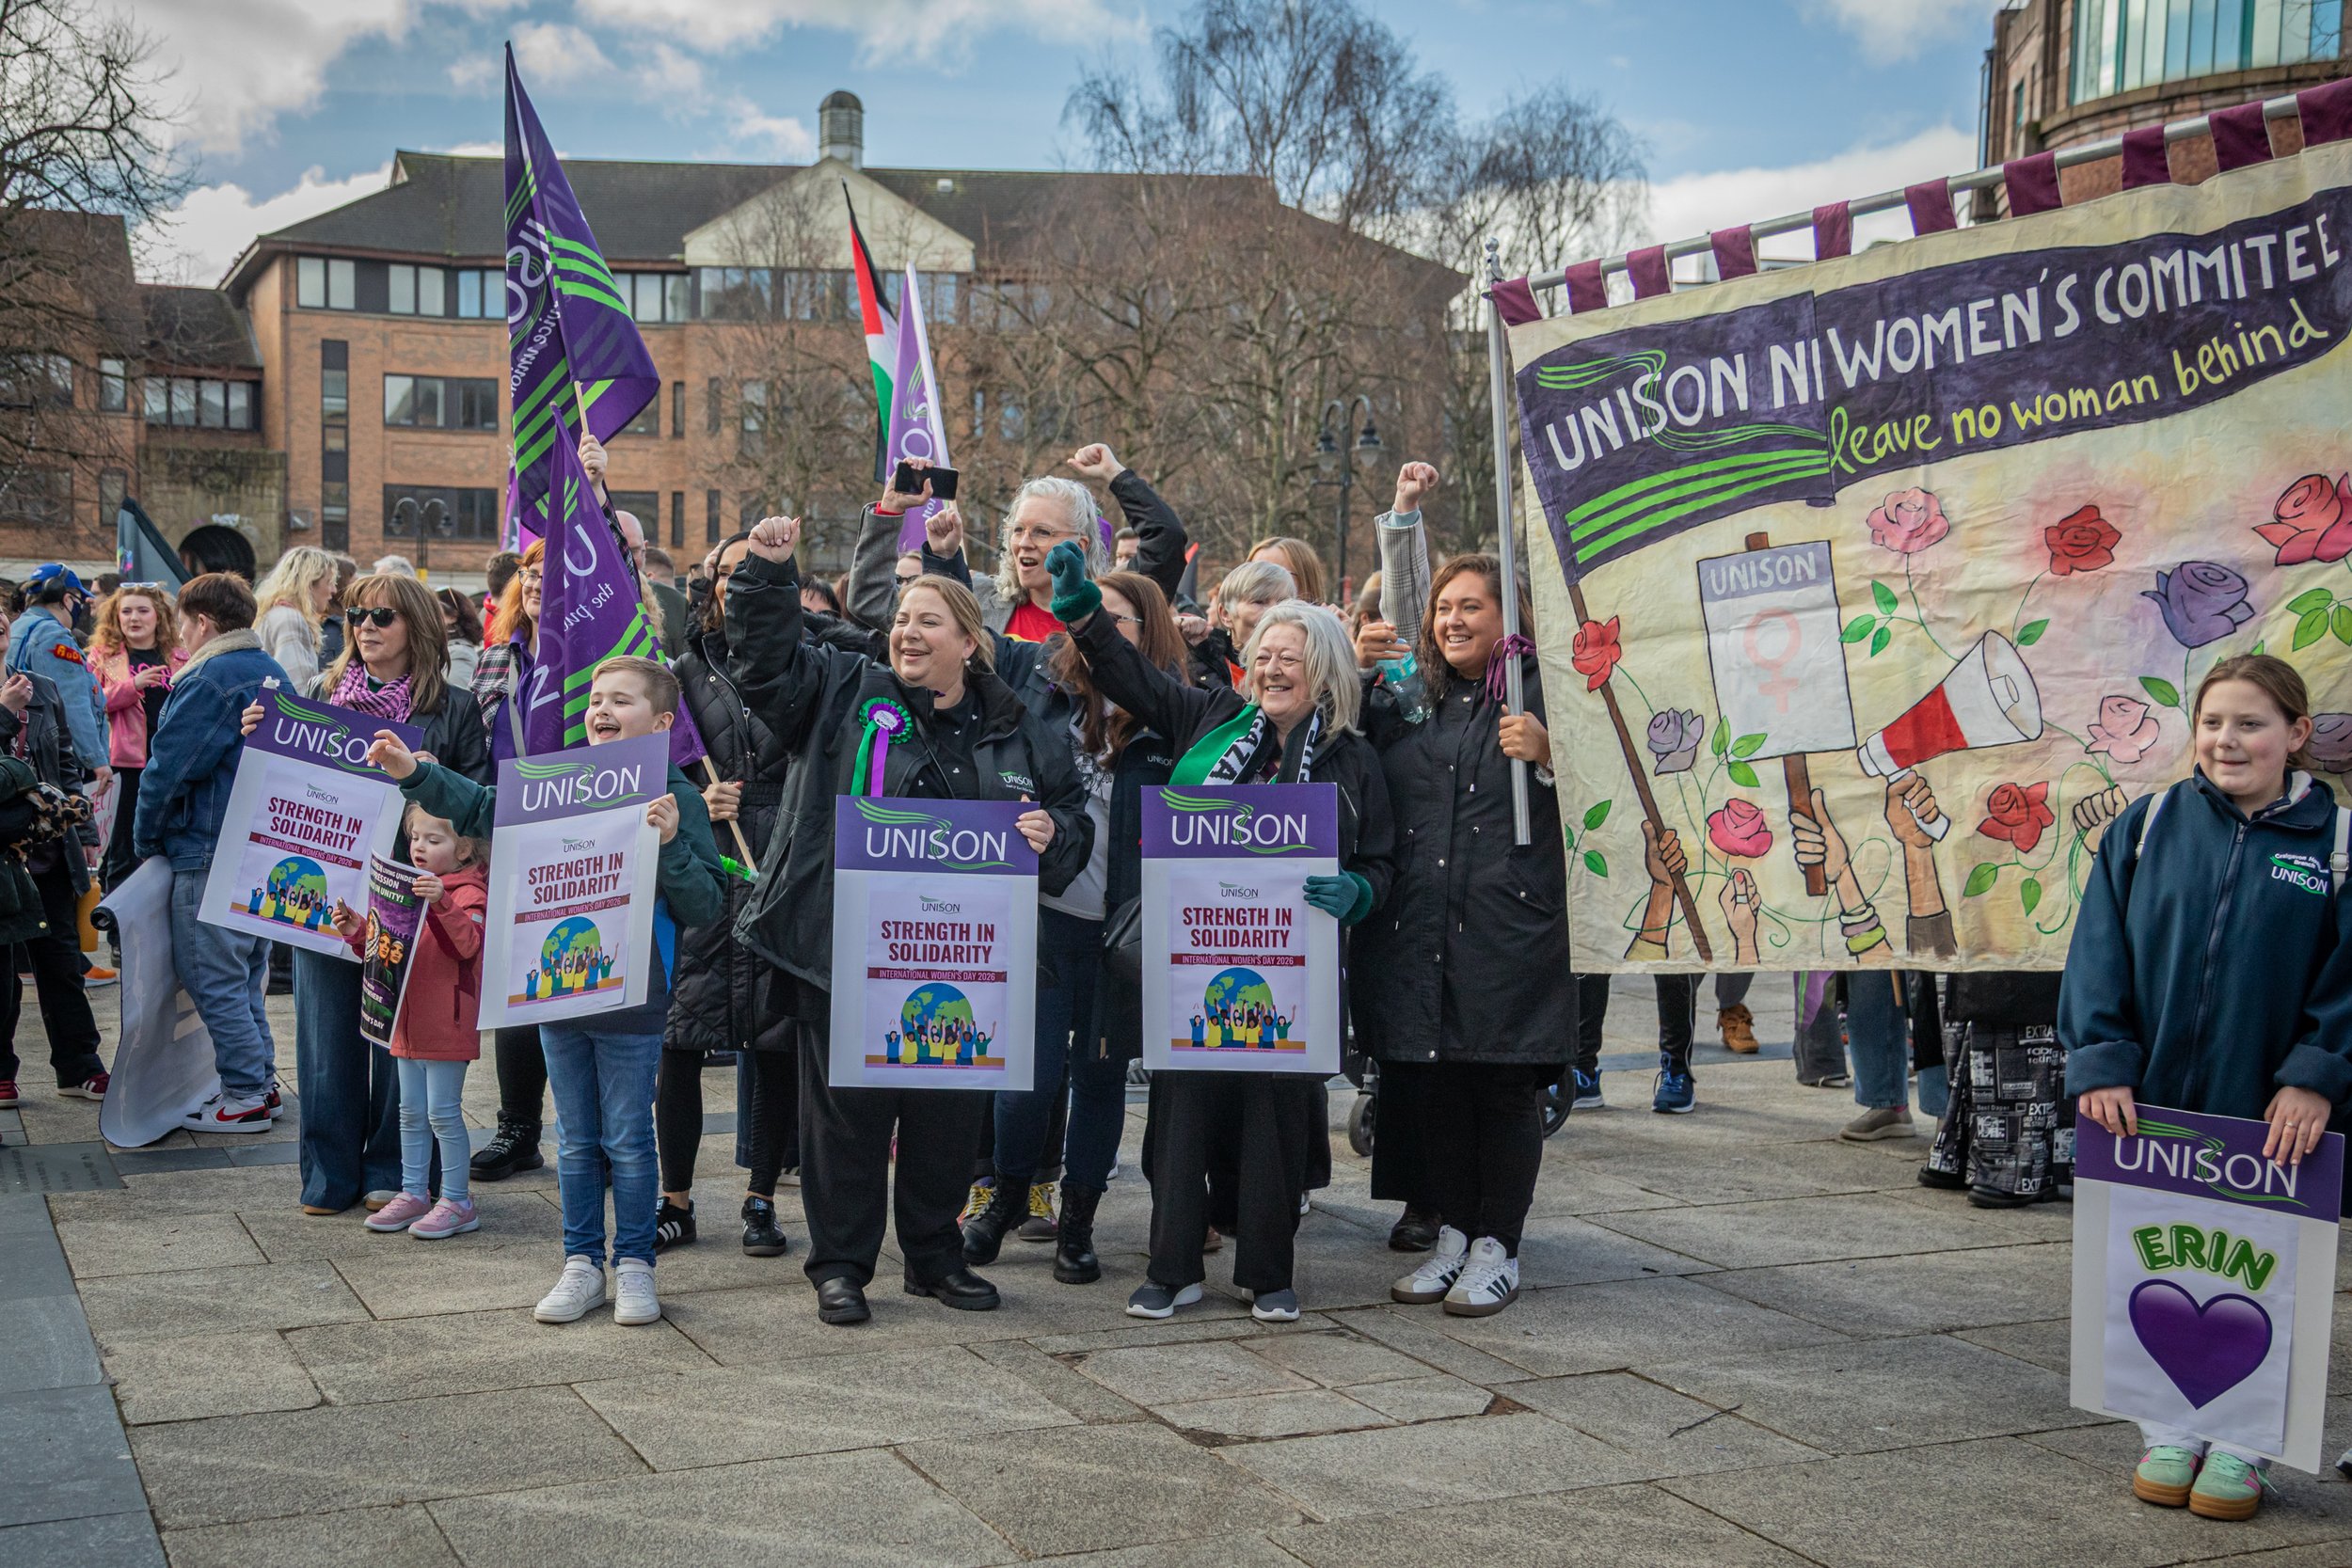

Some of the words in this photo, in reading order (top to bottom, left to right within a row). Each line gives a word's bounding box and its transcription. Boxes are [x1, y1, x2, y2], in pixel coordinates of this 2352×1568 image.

[1546, 354, 1748, 470] UNISON
[1770, 338, 1824, 409] NI
[1826, 267, 2080, 388] WOMEN'S
[2094, 213, 2340, 325] COMMITEE
[1830, 405, 1942, 474] leave
[1951, 403, 2002, 444] no
[2010, 374, 2159, 431] woman
[2172, 297, 2328, 397] behind
[1709, 551, 1817, 595] UNISON
[274, 719, 374, 765] UNISO
[307, 790, 339, 804] UNISON
[521, 764, 642, 812] UNISON
[268, 798, 345, 830] STRENGTH
[346, 816, 363, 835] IN
[1171, 814, 1308, 846] UNISON
[270, 816, 357, 851] SOLIDARITY
[564, 839, 596, 852] UNISON
[866, 827, 1008, 862] UNISON
[260, 836, 301, 852] INTERNATIONAL
[326, 851, 337, 863] DAY
[338, 854, 353, 866] 2026
[528, 855, 603, 886] STRENGTH
[608, 851, 624, 872] IN
[2271, 865, 2328, 894] UNISON
[380, 887, 405, 903] UNITY!
[533, 872, 621, 905] SOLIDARITY
[1221, 888, 1259, 898] UNISON
[524, 909, 566, 922] INTERNATIONAL
[595, 900, 607, 911] DAY
[922, 902, 961, 913] UNISON
[1183, 907, 1270, 927] STRENGTH
[1275, 907, 1293, 927] IN
[881, 920, 971, 942] STRENGTH
[977, 923, 995, 942] IN
[1190, 928, 1291, 948] SOLIDARITY
[888, 942, 993, 964] SOLIDARITY
[1182, 954, 1231, 965] INTERNATIONAL
[1232, 955, 1262, 965] WOMEN'S
[1262, 956, 1276, 966] DAY
[1276, 956, 1295, 966] 2026
[879, 969, 930, 980] INTERNATIONAL
[930, 970, 962, 981] WOMEN'S
[962, 971, 977, 981] DAY
[977, 972, 995, 982] 2026
[373, 1019, 385, 1030] DAY
[2114, 1136, 2298, 1198] UNISON
[2133, 1224, 2276, 1291] ERIN
